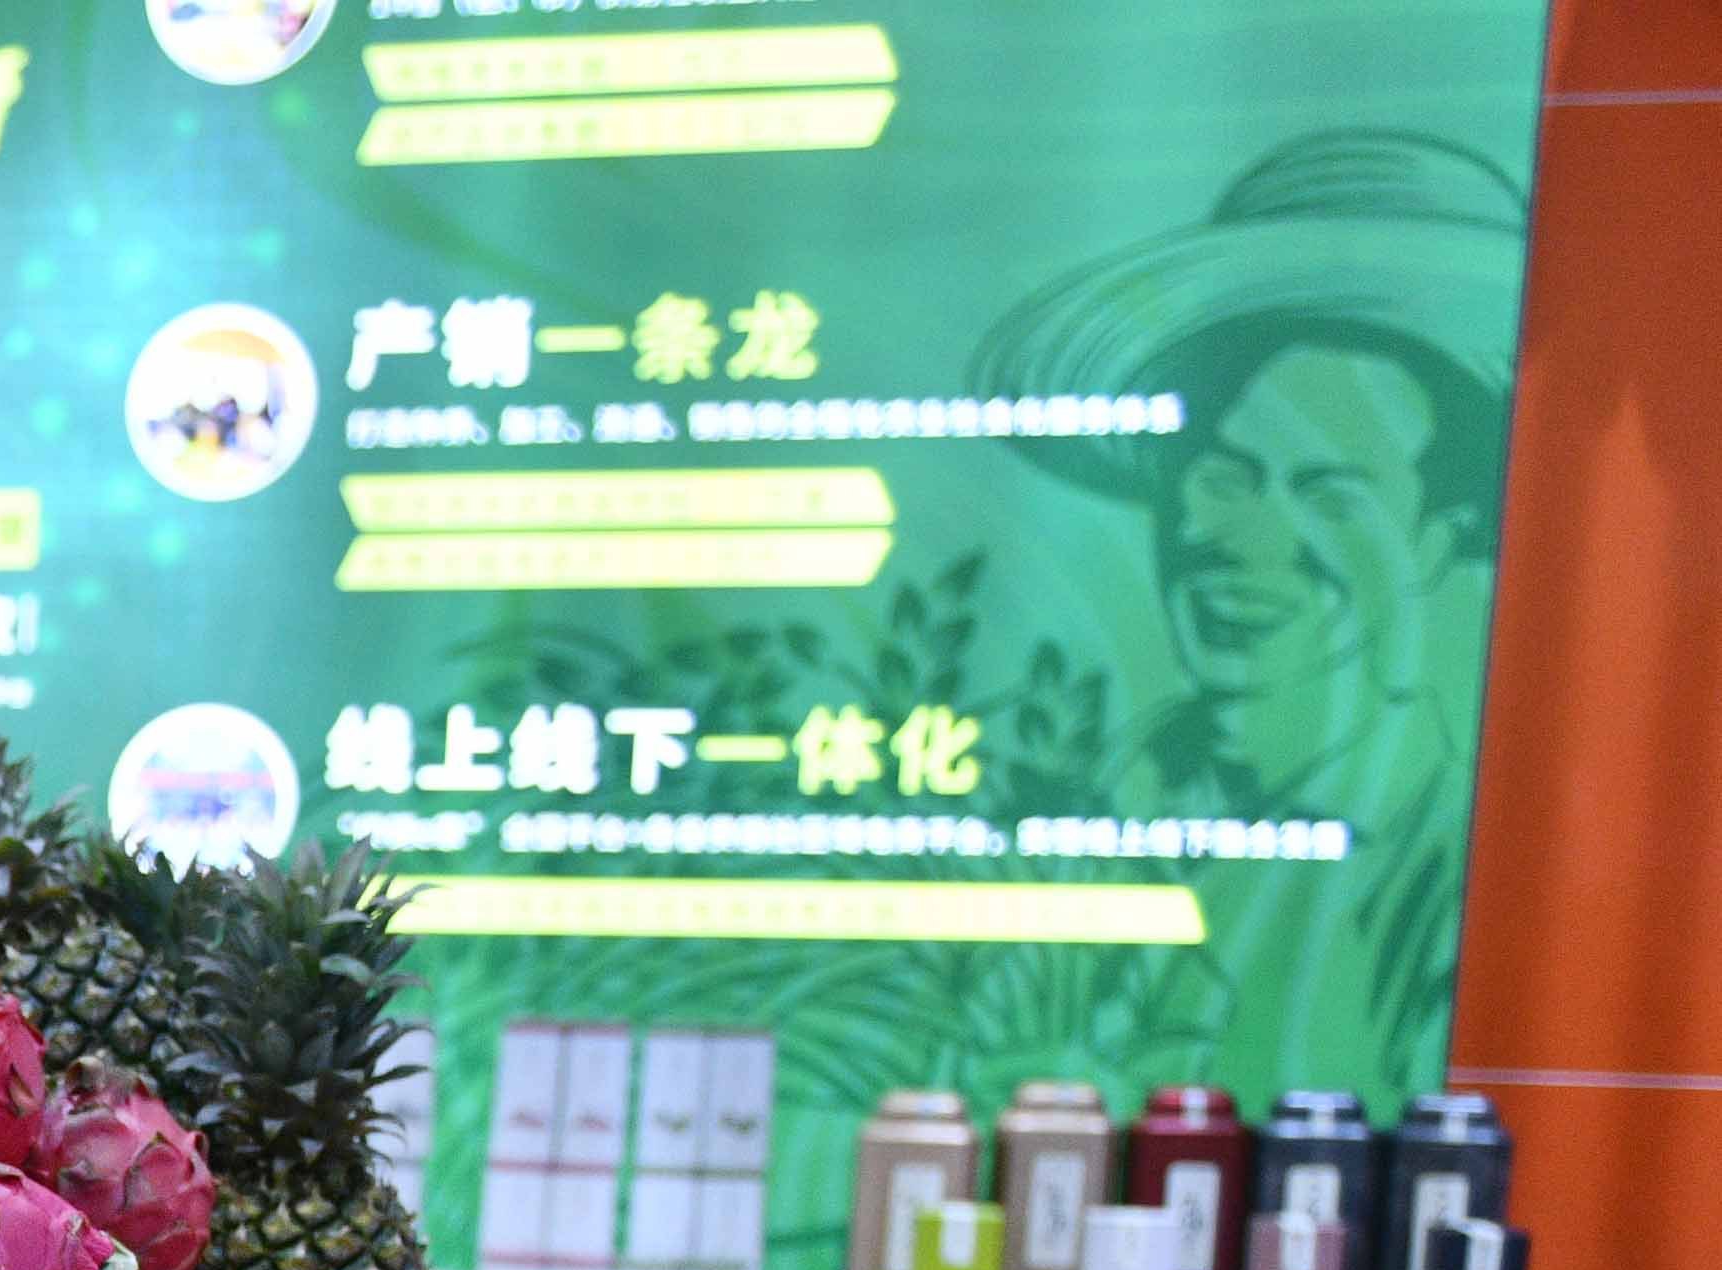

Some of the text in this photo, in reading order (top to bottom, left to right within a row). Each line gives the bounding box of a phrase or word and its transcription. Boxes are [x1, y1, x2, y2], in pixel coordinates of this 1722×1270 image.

[325, 702, 981, 796] 线上线下一体化
